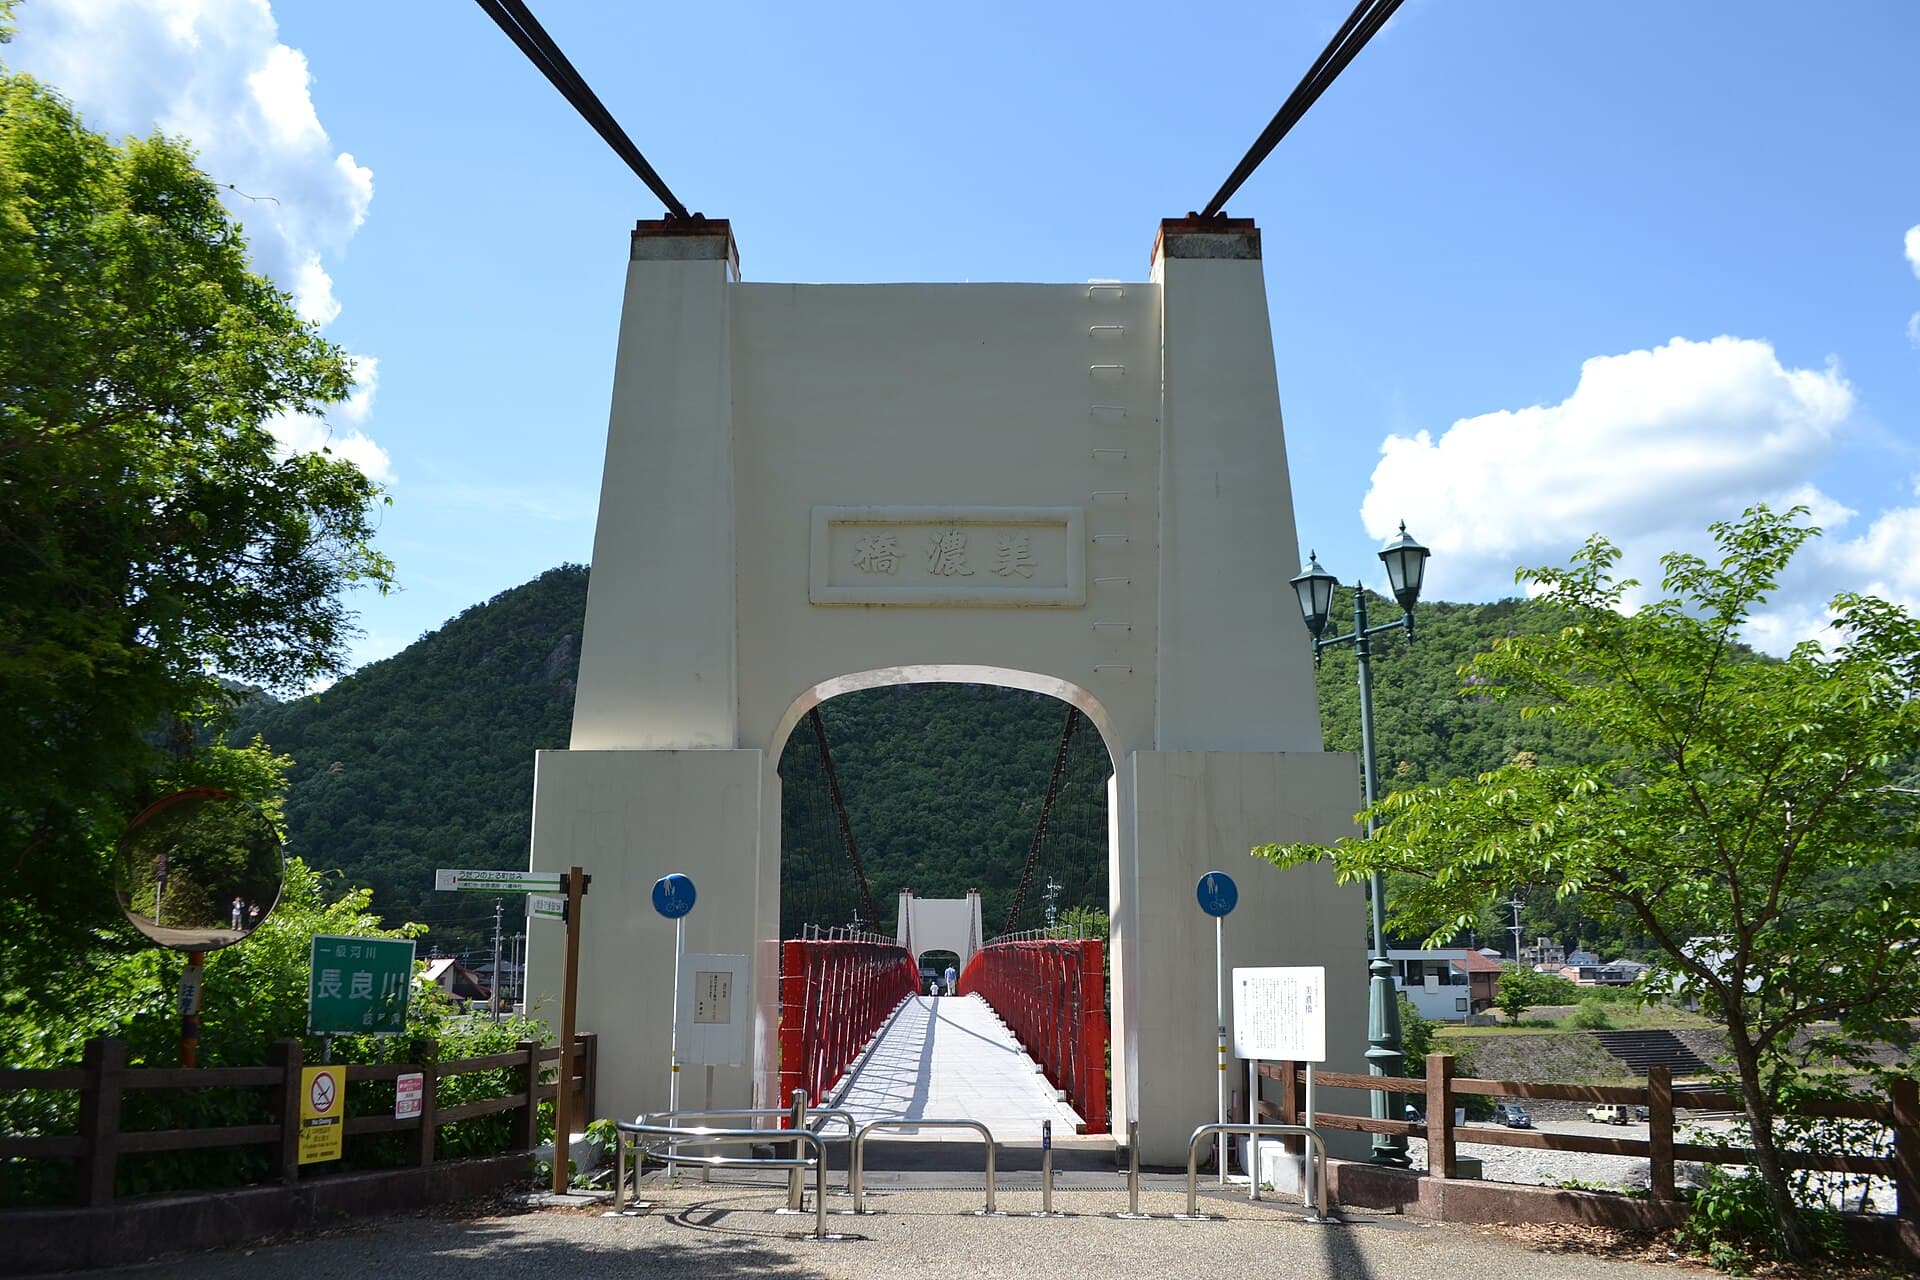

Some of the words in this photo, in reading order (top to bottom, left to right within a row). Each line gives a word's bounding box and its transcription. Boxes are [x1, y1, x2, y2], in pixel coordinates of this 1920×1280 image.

[320, 945, 376, 959] 一級河川
[317, 969, 405, 1001] 長良川
